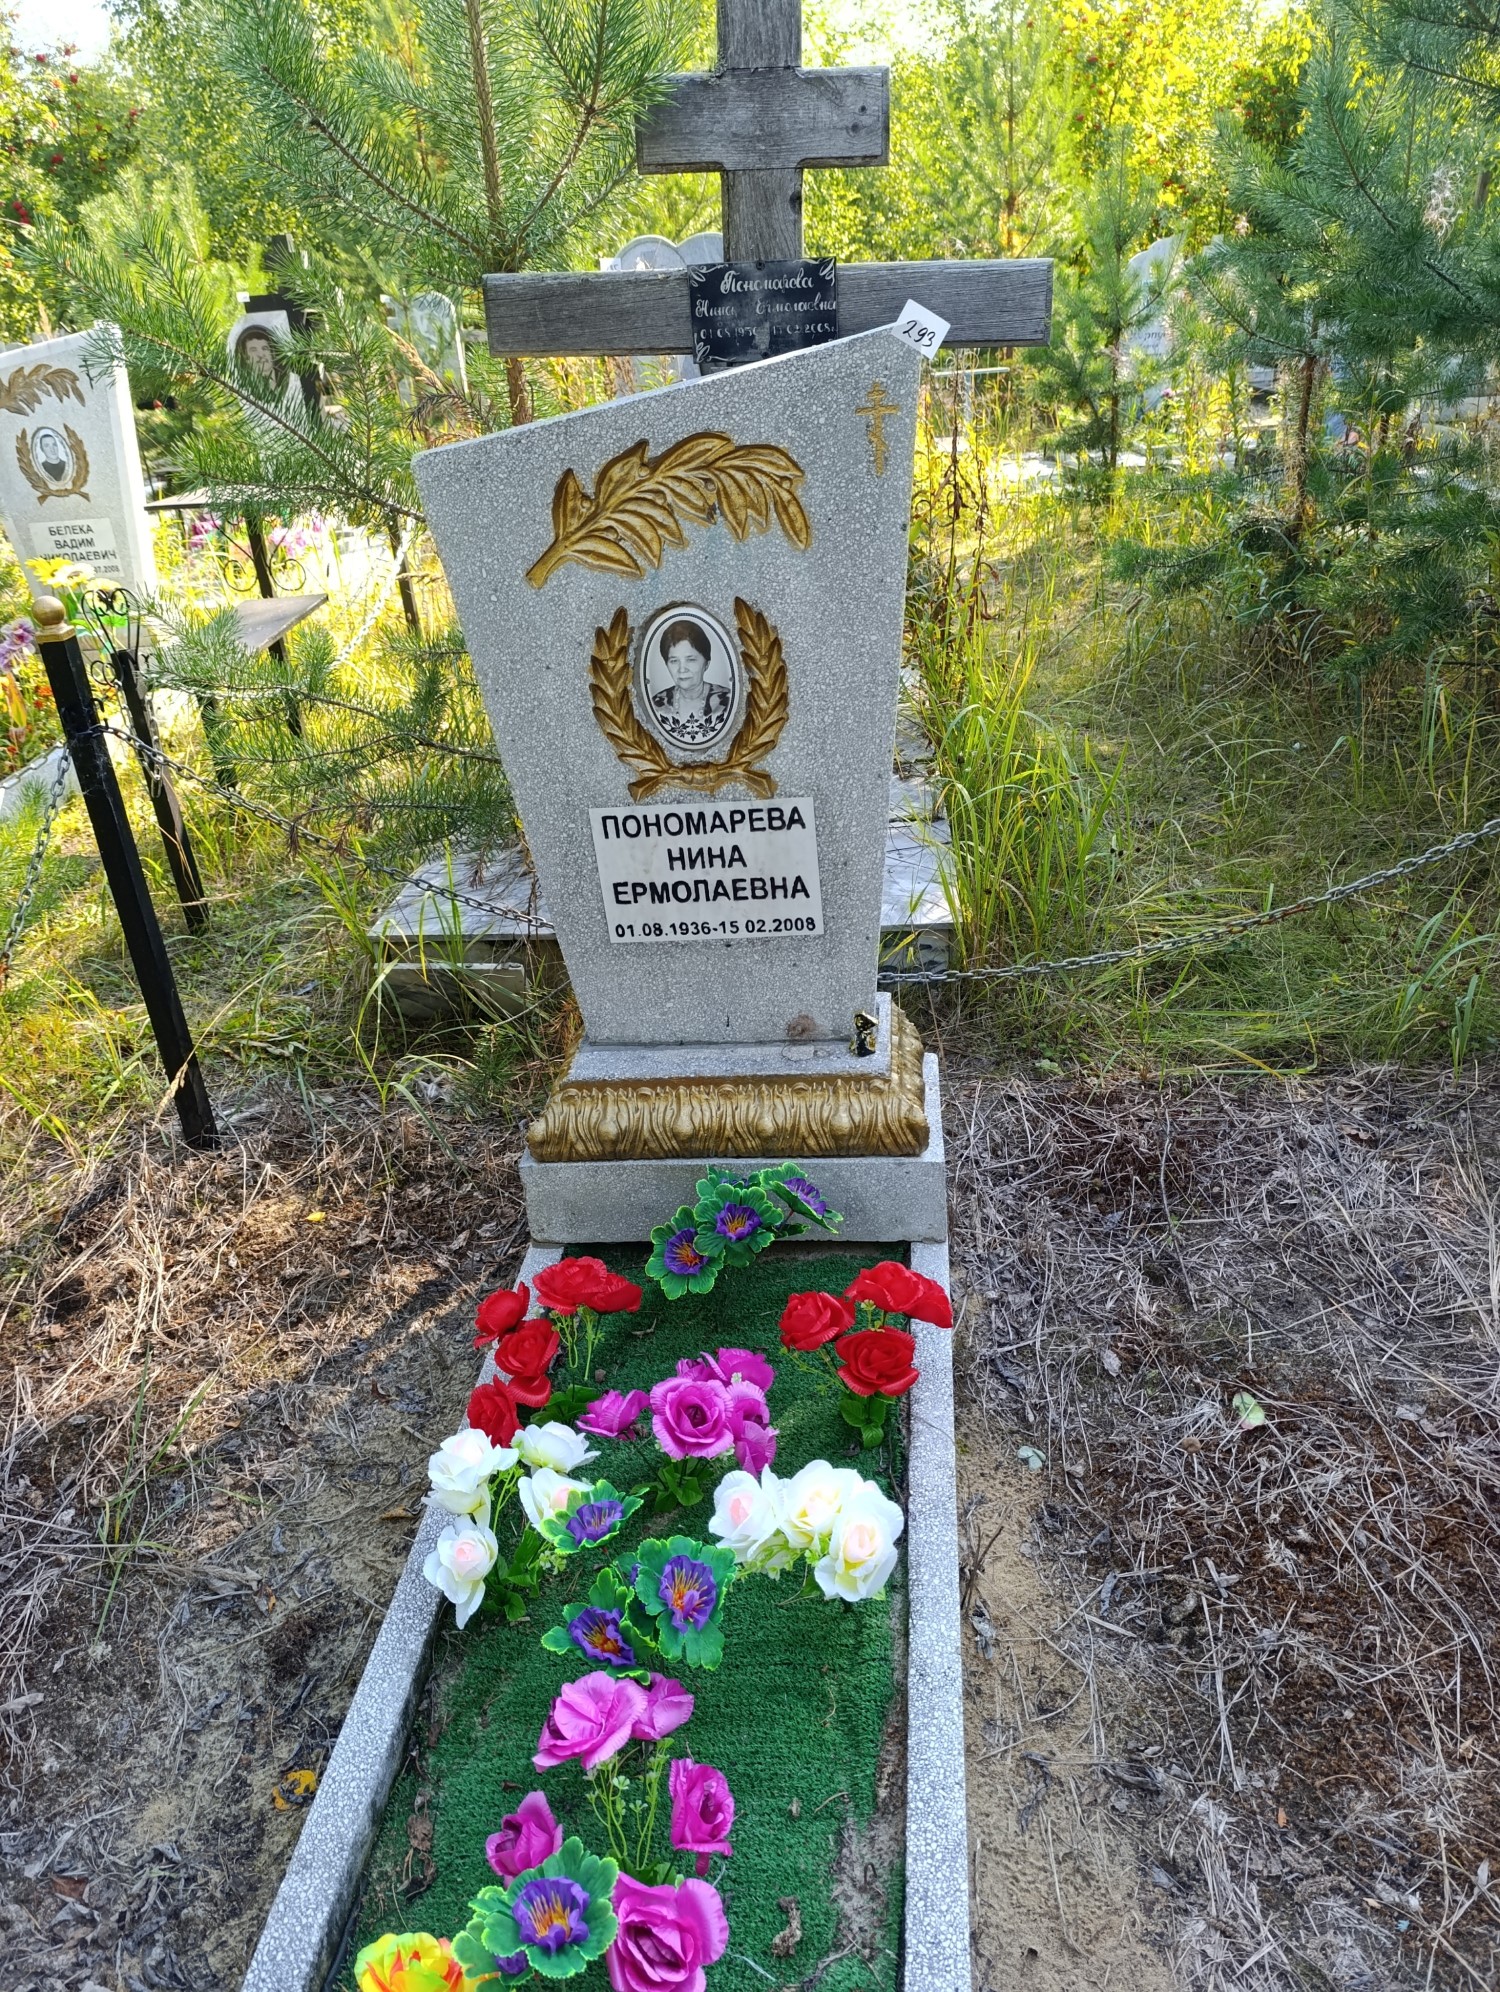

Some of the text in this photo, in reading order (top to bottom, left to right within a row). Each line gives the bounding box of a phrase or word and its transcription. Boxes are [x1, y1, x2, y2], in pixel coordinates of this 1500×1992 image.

[902, 319, 936, 347] 293
[48, 524, 95, 536] БЕЛЕКА
[54, 537, 96, 550] ВАДИМ
[601, 806, 807, 840] ПОНОМАРЕВА
[667, 844, 748, 872] НИНА
[612, 875, 811, 905] ЕРМОЛАЕВНА
